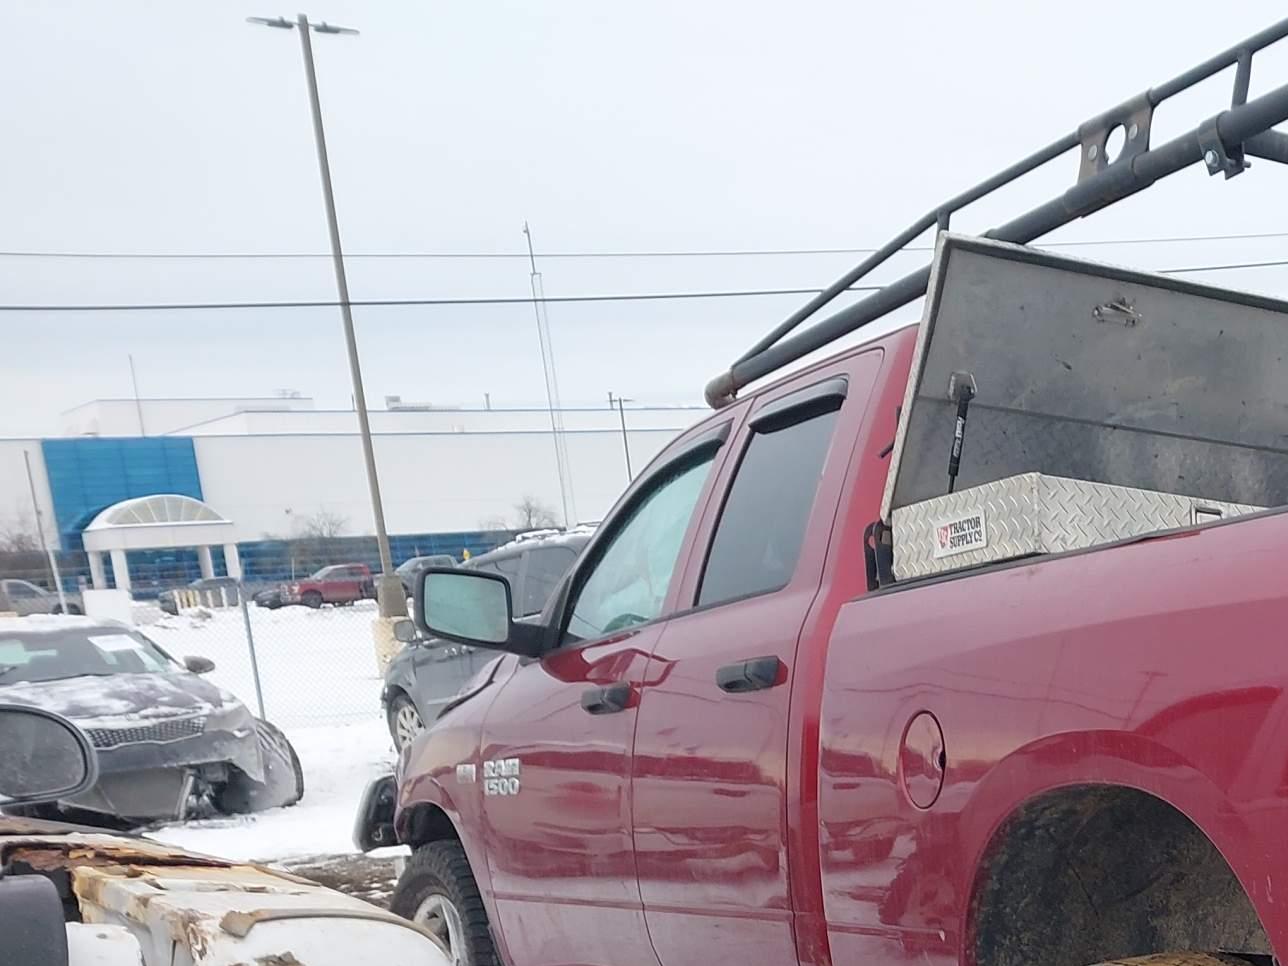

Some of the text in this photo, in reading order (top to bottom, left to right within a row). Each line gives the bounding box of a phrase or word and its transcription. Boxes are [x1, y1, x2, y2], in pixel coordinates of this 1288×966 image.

[949, 516, 981, 536] TRACTOR
[950, 531, 973, 549] SUPPLY
[483, 758, 520, 777] RAM
[484, 777, 520, 796] 1500
